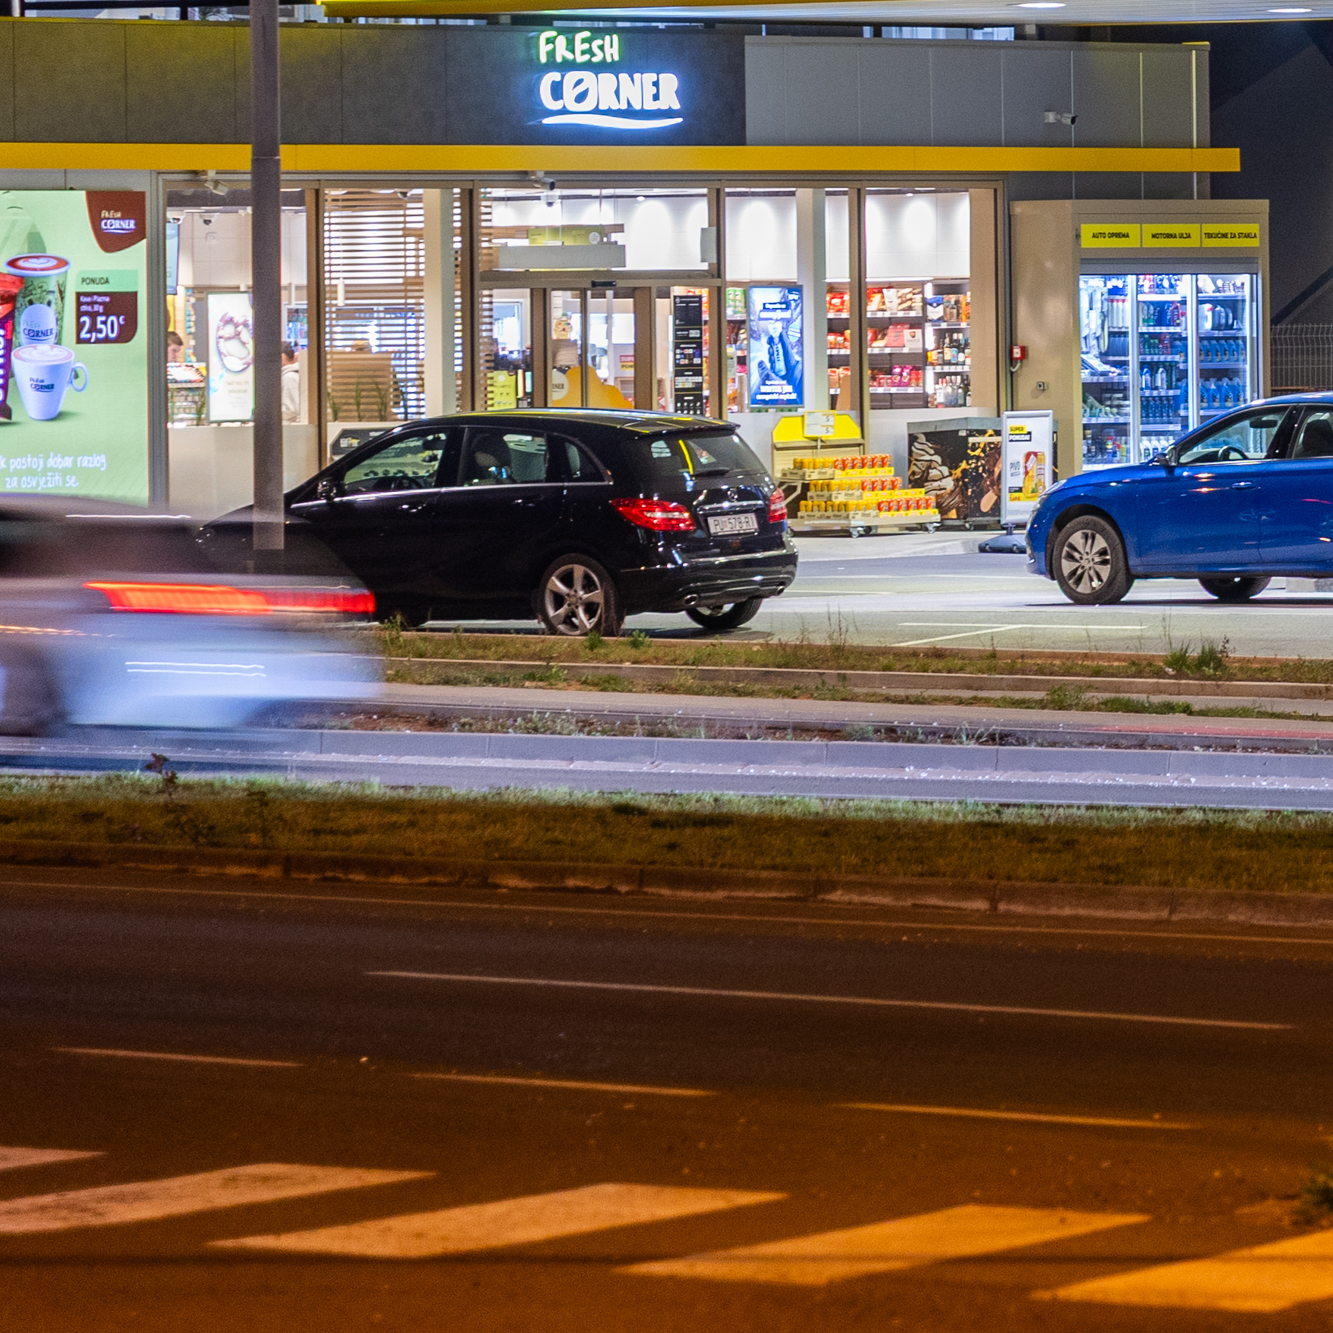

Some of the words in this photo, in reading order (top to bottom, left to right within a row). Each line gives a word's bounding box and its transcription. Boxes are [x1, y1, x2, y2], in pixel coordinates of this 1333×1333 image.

[539, 30, 620, 63] FRESH
[81, 277, 110, 285] PONUDA
[9, 453, 43, 471] postoji
[47, 452, 74, 467] dobar
[77, 453, 107, 471] razlog
[5, 477, 18, 488] za
[713, 519, 724, 531] PU
